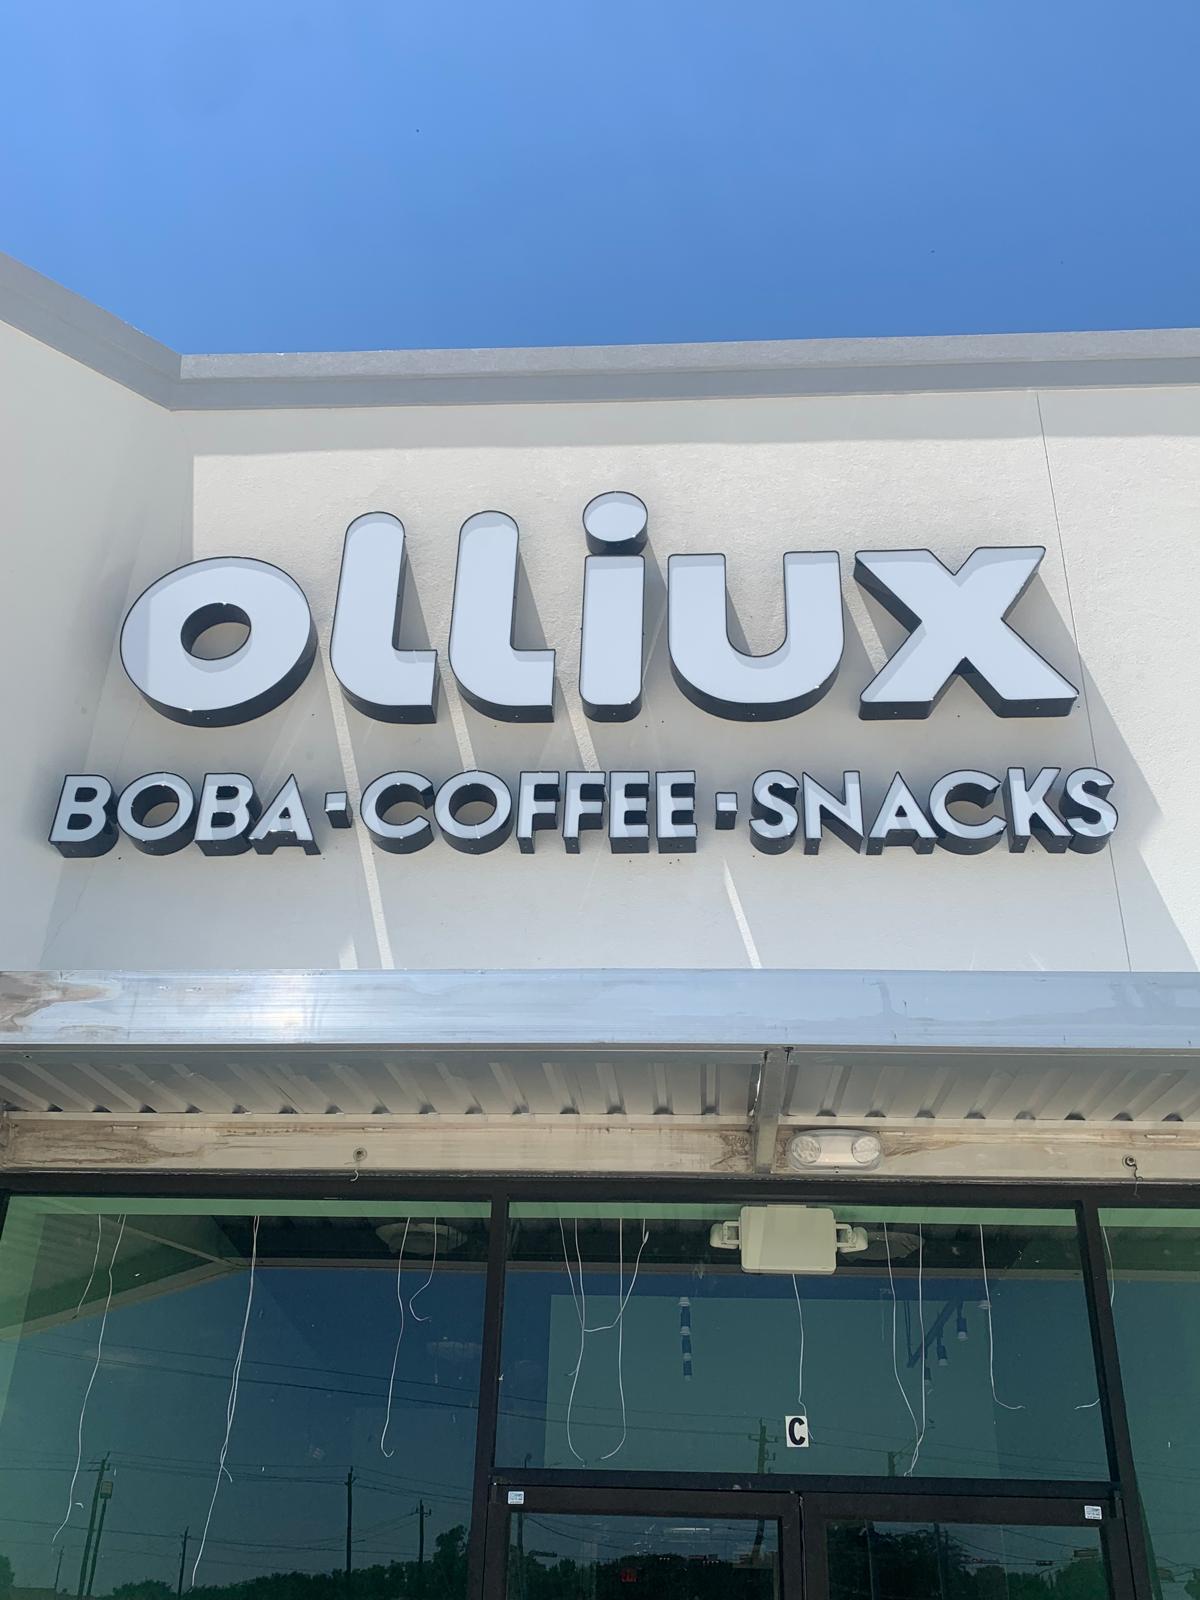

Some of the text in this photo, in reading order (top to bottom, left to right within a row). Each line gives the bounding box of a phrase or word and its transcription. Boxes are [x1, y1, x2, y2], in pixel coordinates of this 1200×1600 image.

[120, 491, 1078, 726] olliux
[49, 767, 1119, 856] BOBA COFFEE SNACKS
[788, 1417, 806, 1446] C
